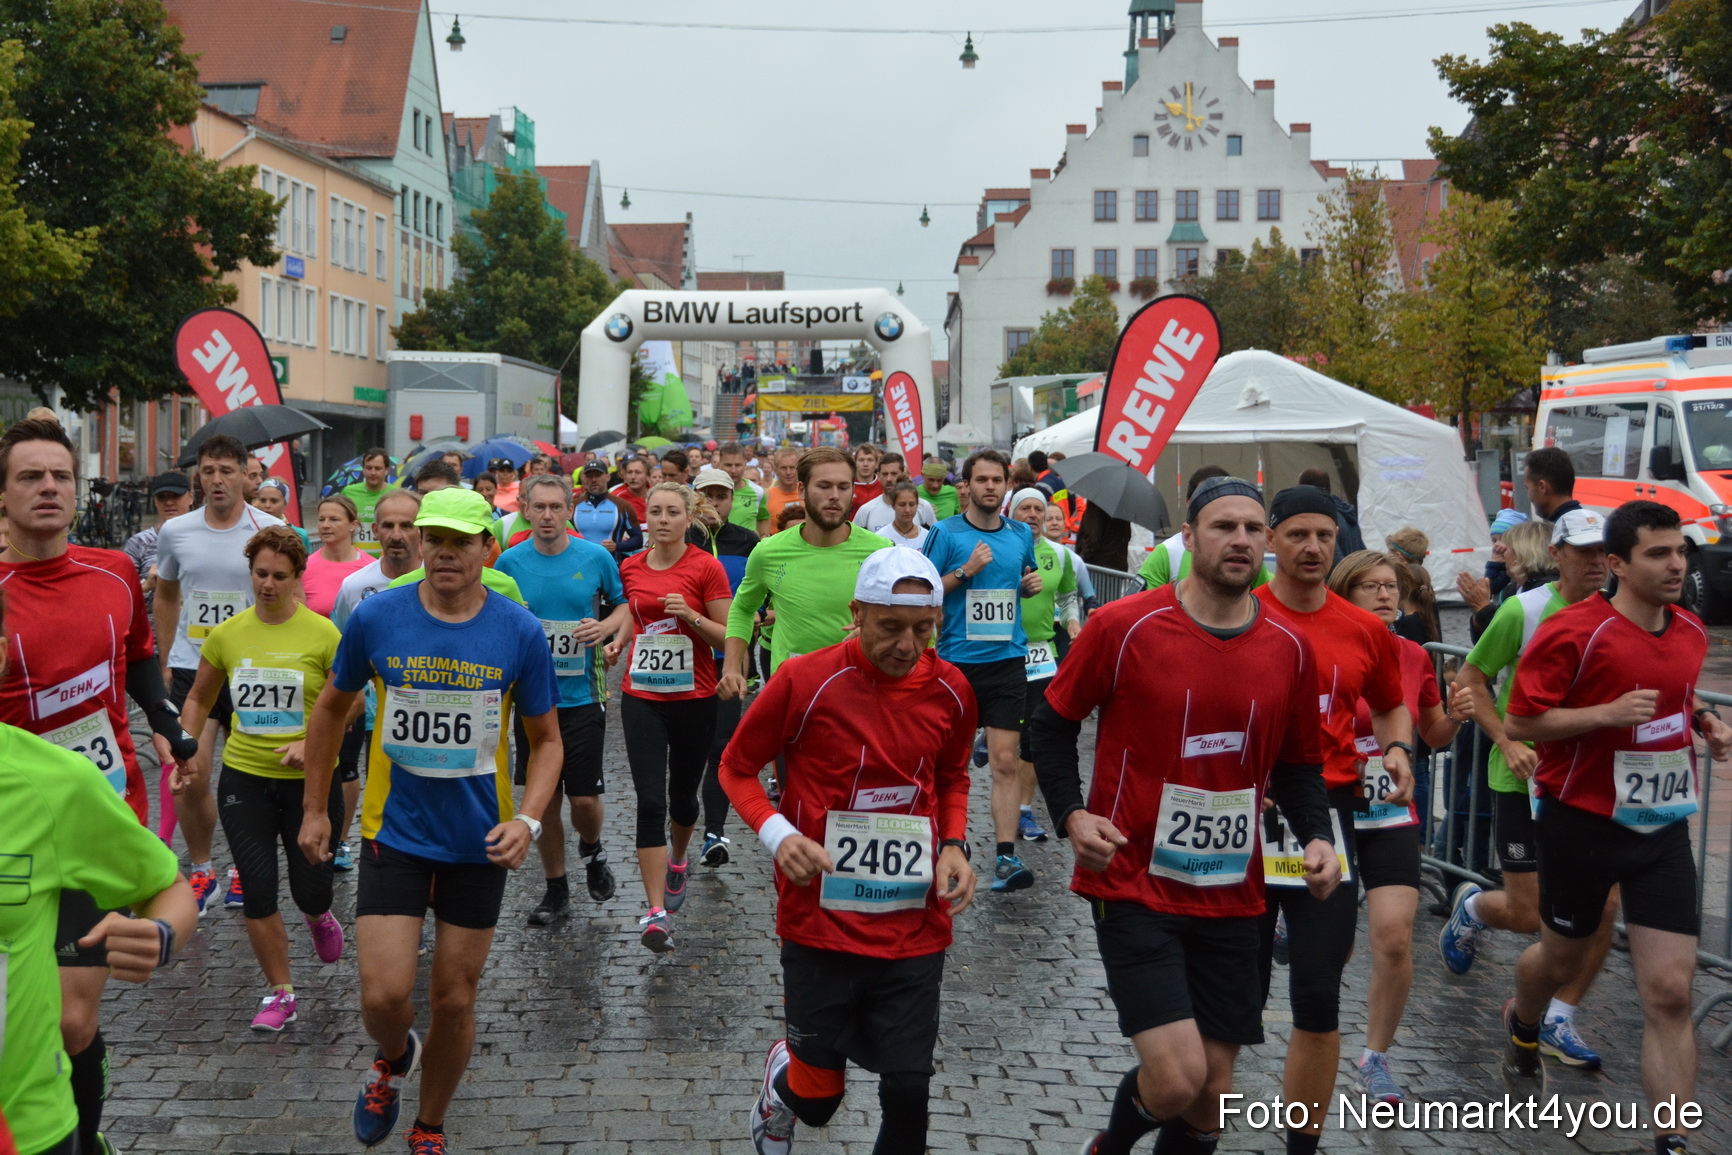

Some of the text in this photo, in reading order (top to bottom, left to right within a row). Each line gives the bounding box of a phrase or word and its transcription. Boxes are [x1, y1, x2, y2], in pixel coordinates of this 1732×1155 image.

[643, 301, 720, 323] BMW
[728, 301, 864, 328] Laufsport
[1106, 318, 1205, 467] REWE
[803, 398, 829, 408] ZIEL
[972, 601, 1014, 621] 3018
[386, 656, 503, 680] 10. NEUMARKTER
[637, 648, 685, 671] 2521
[262, 670, 297, 679] BOCK
[402, 670, 484, 690] STADTLAUF
[647, 676, 676, 685] Annika
[60, 678, 93, 703] DEHN
[238, 683, 297, 708] 2217
[425, 692, 473, 705] BOCK
[254, 714, 279, 725] Julia
[392, 709, 472, 745] 3056
[1650, 722, 1671, 735] DEHN
[52, 716, 102, 745] BOCK
[1200, 738, 1226, 749] DEHN
[1625, 769, 1689, 804] 2104
[871, 792, 899, 803] DEHN
[1170, 795, 1206, 807] NeuerMarkt
[1212, 792, 1250, 807] BOCK
[835, 822, 870, 830] NeuerMarkt
[876, 816, 924, 832] BOCK
[1636, 811, 1676, 823] Florian
[1167, 810, 1248, 850] 2538
[835, 836, 923, 877] 2462
[1182, 857, 1224, 875] Jürgen
[854, 883, 900, 900] Daniel
